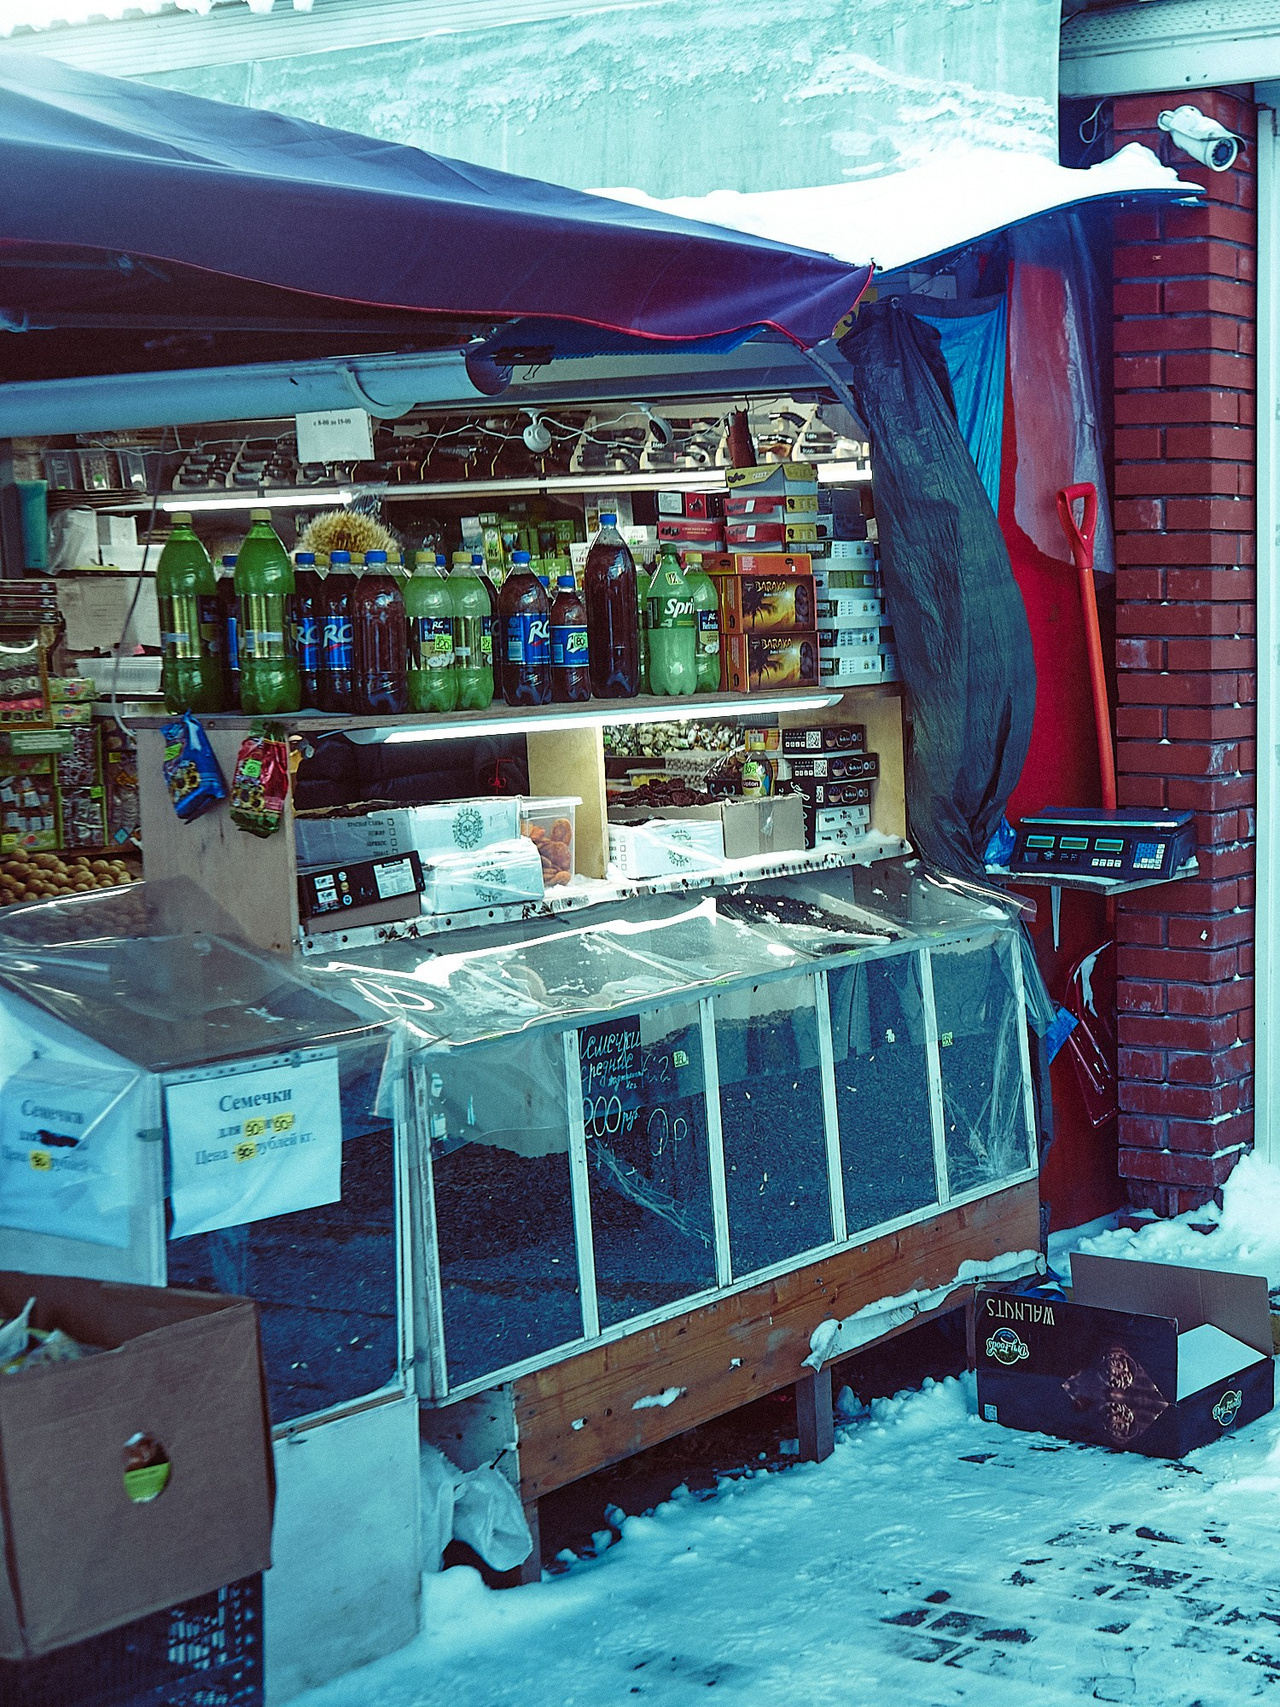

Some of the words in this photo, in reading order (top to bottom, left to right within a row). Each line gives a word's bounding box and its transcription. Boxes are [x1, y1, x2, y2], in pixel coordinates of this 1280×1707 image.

[664, 598, 694, 618] Spri
[323, 624, 353, 648] RC
[219, 1089, 292, 1112] Семечки
[195, 1150, 229, 1165] Цена
[986, 1298, 1055, 1326] WALNUTS
